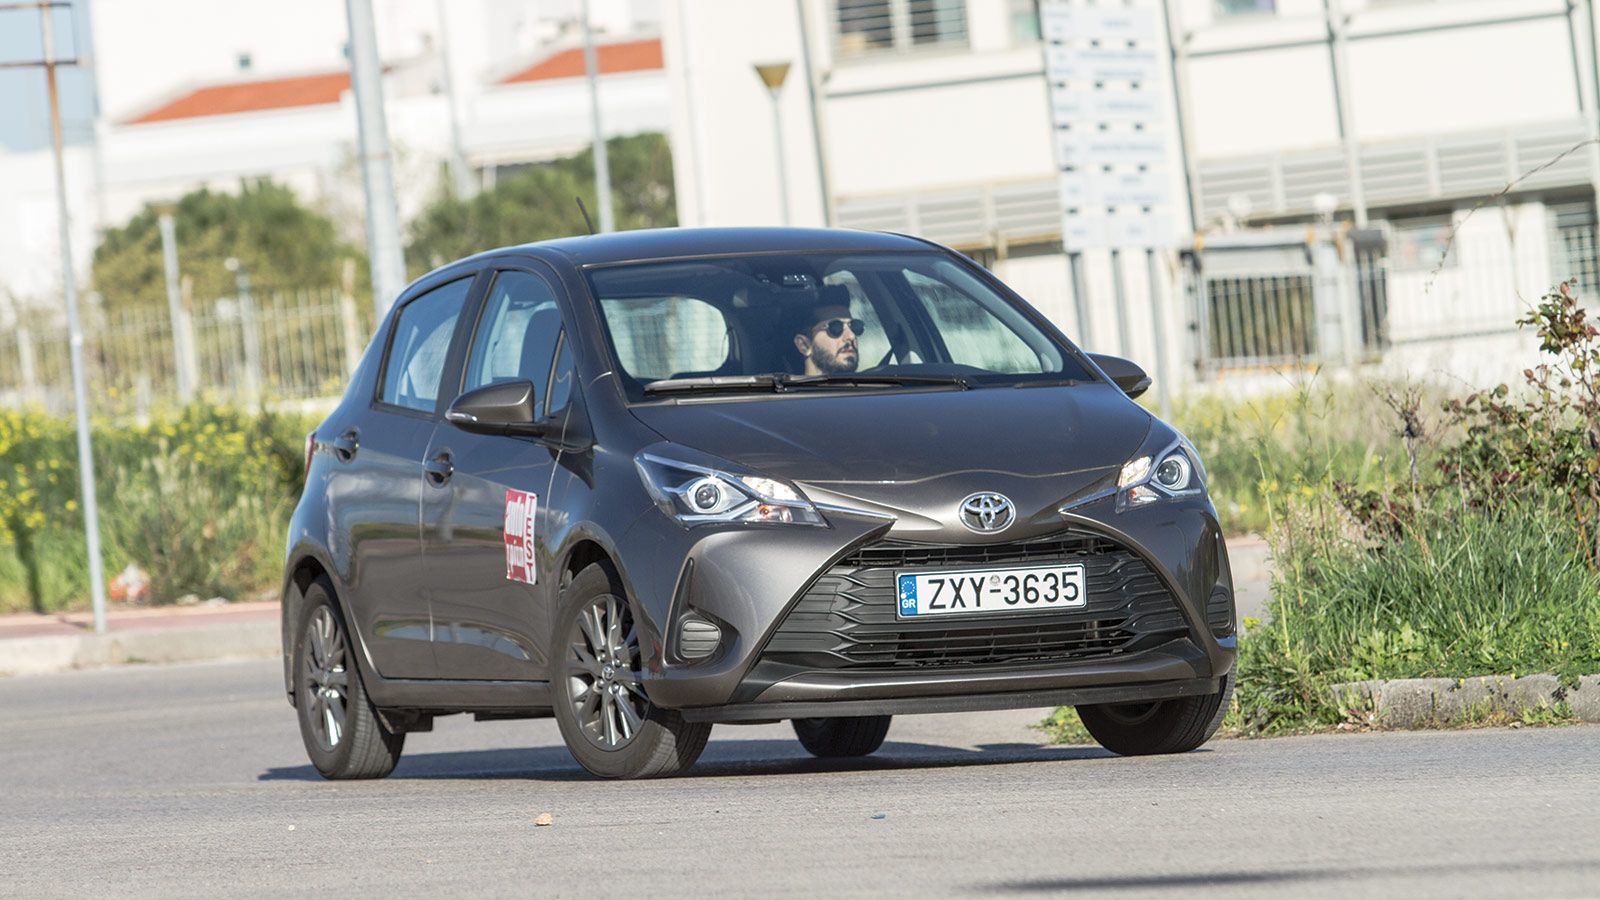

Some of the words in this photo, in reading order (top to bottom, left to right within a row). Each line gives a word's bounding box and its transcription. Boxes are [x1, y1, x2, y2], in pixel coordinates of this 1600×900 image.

[525, 495, 536, 582] TEST
[902, 599, 916, 609] GR
[928, 571, 1079, 610] ZXY-3635
